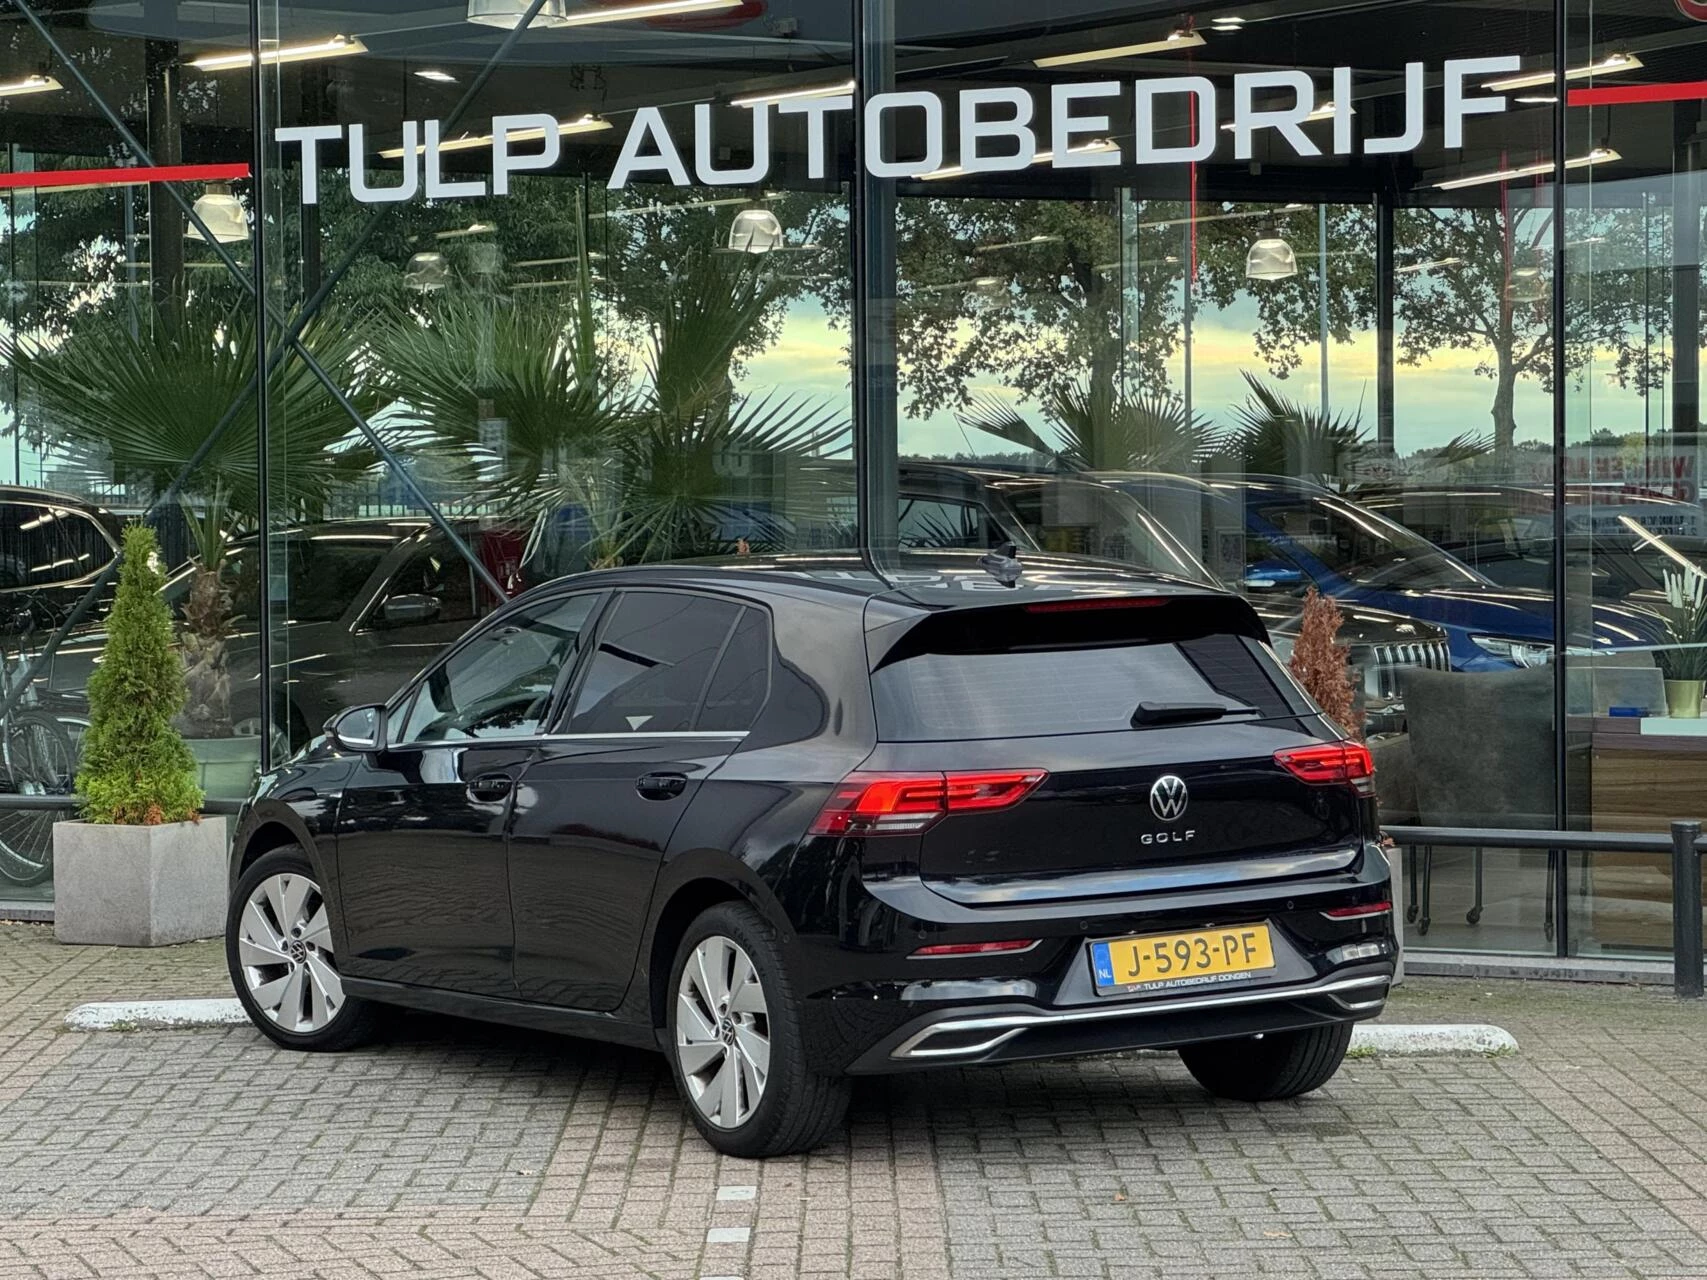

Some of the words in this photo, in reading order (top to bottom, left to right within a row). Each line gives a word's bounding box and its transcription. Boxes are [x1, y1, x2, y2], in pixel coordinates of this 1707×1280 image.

[275, 113, 561, 205] TULP
[606, 54, 1521, 190] AUTOBEDRIJF
[1140, 830, 1196, 845] GOLF
[1128, 932, 1257, 977] J-593-PF
[1098, 969, 1112, 979] NL
[1143, 982, 1165, 991] TULP
[1165, 976, 1218, 988] AUTOBEDRIJF
[1218, 972, 1252, 982] DONGEN
